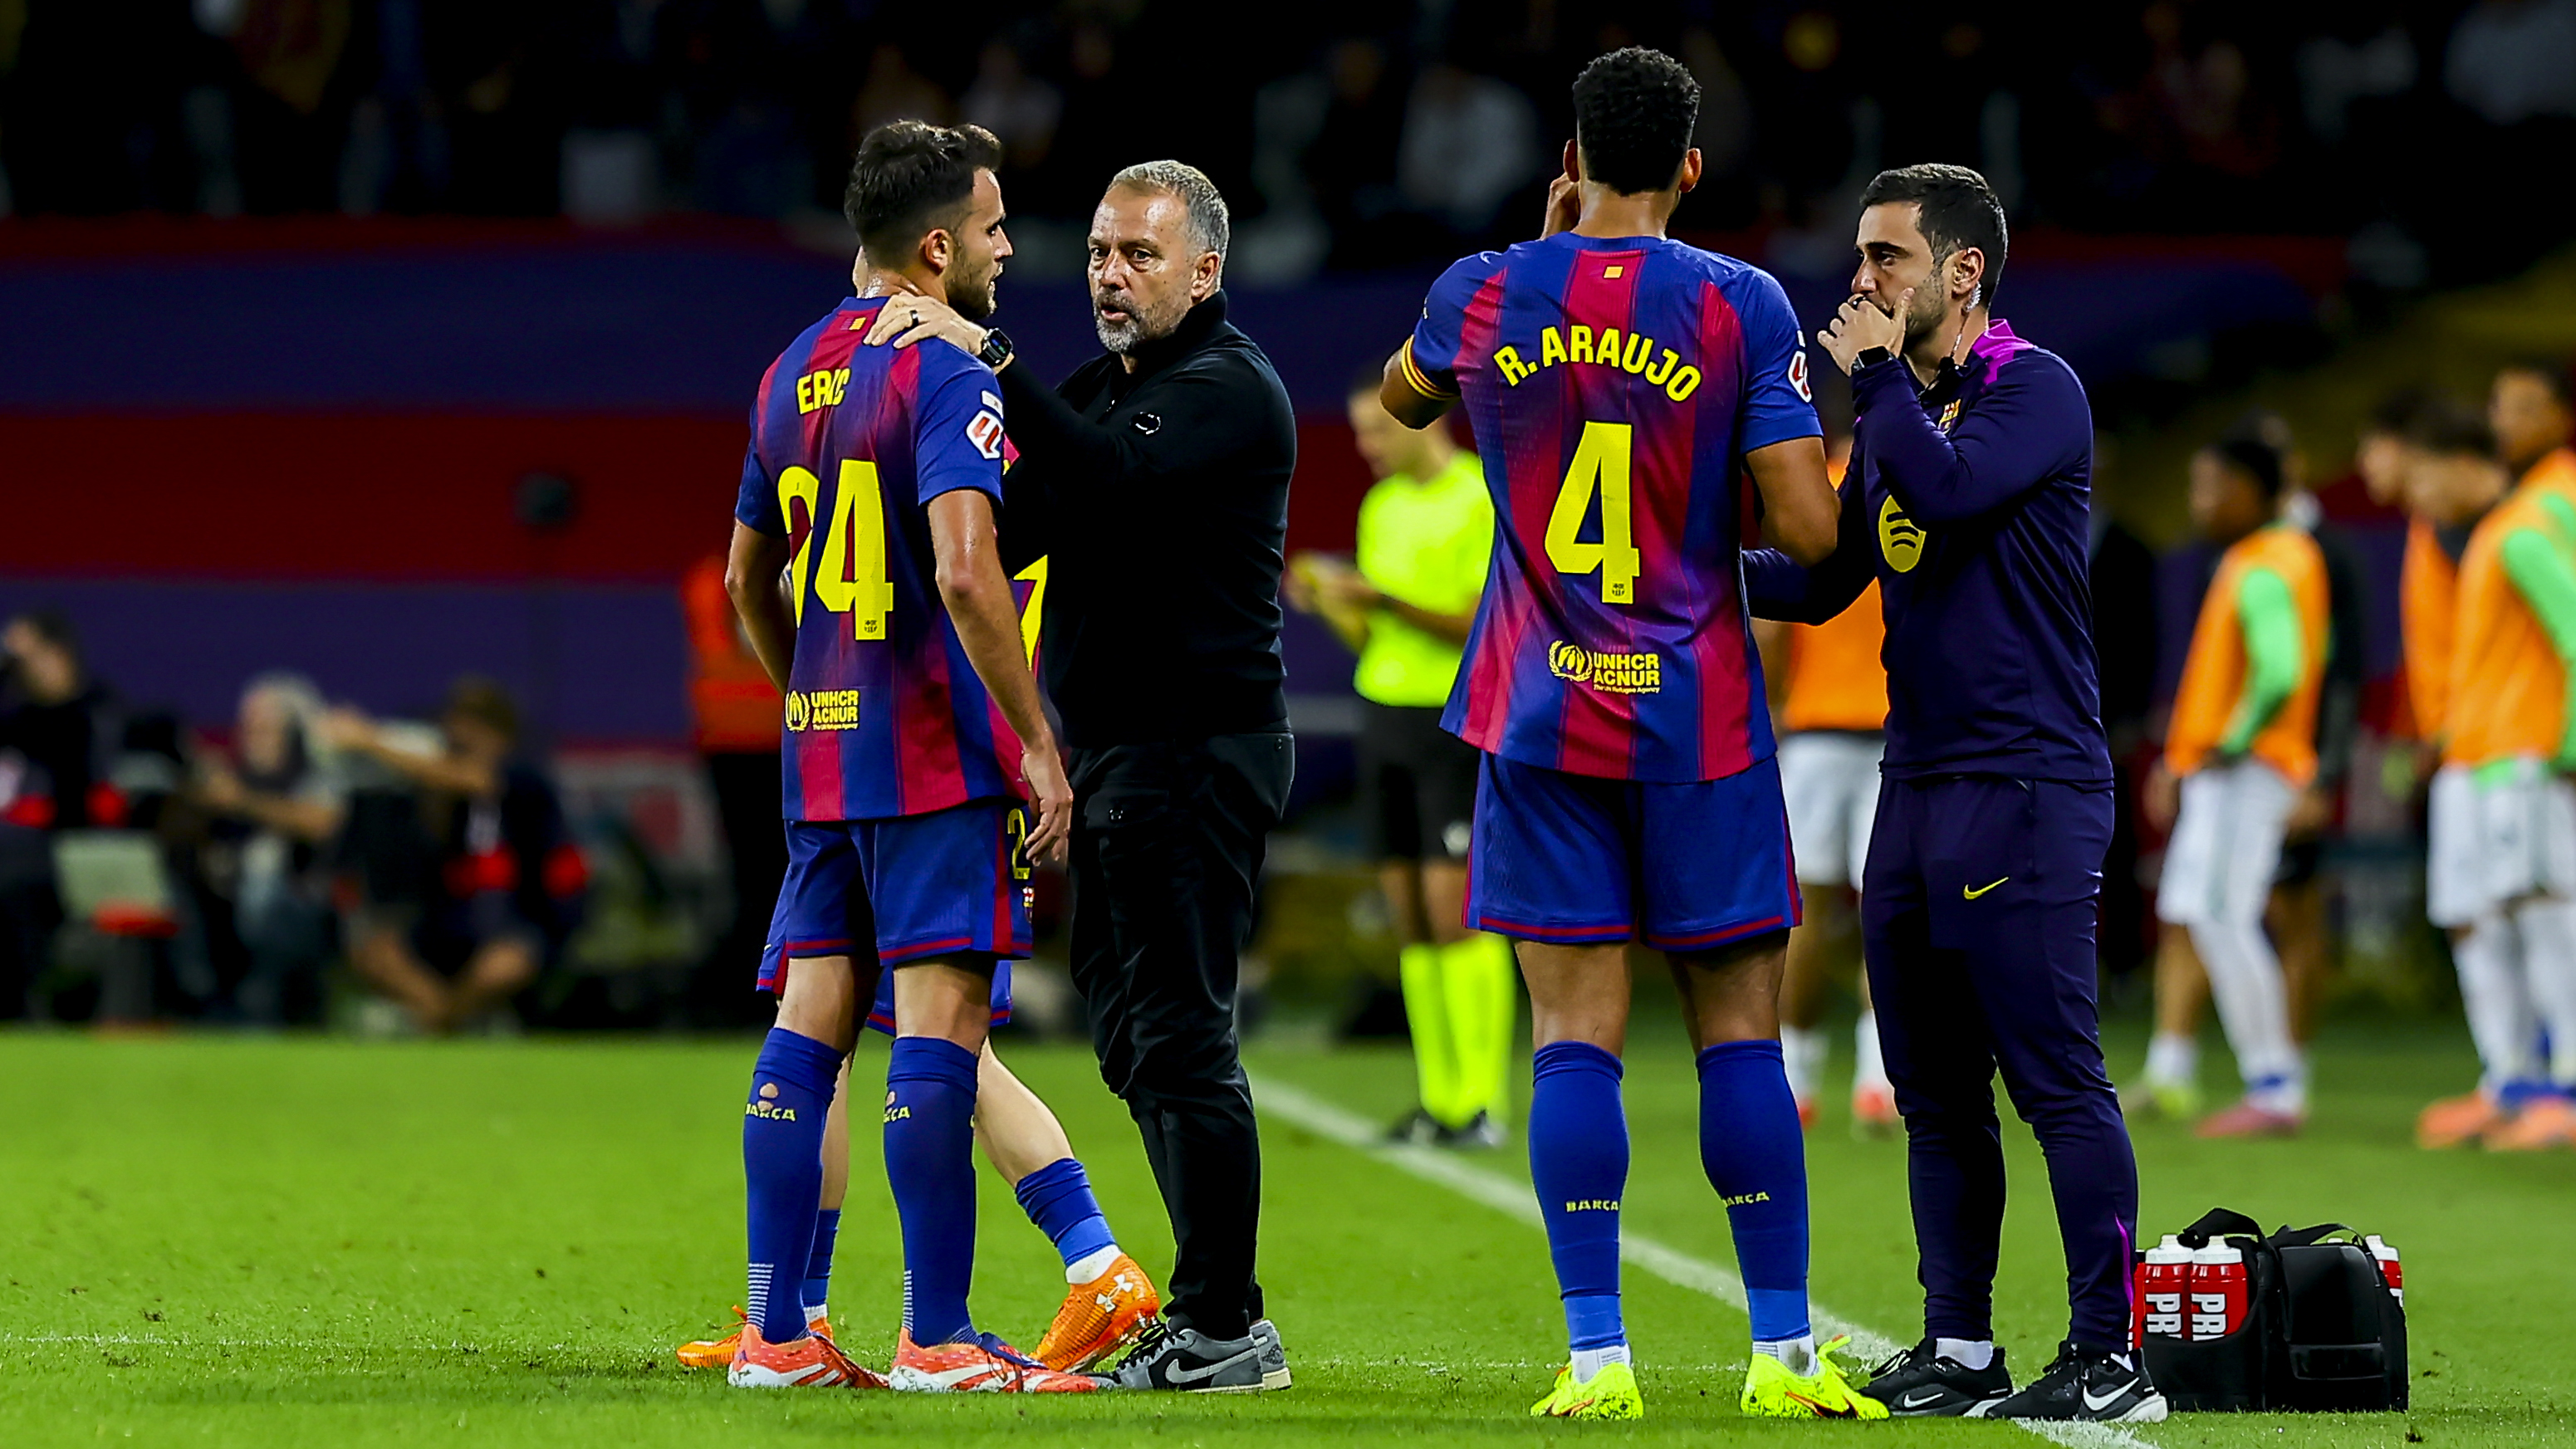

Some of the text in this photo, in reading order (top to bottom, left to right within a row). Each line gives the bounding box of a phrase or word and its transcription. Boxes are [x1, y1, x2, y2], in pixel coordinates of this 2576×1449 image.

[796, 368, 850, 415] ERIC
[1544, 420, 1640, 605] 4
[1594, 652, 1659, 670] UNHCR
[1593, 669, 1660, 686] ACNUR
[811, 690, 859, 707] UNHCR
[811, 706, 858, 724] ACNUR
[2145, 1293, 2182, 1339] PR
